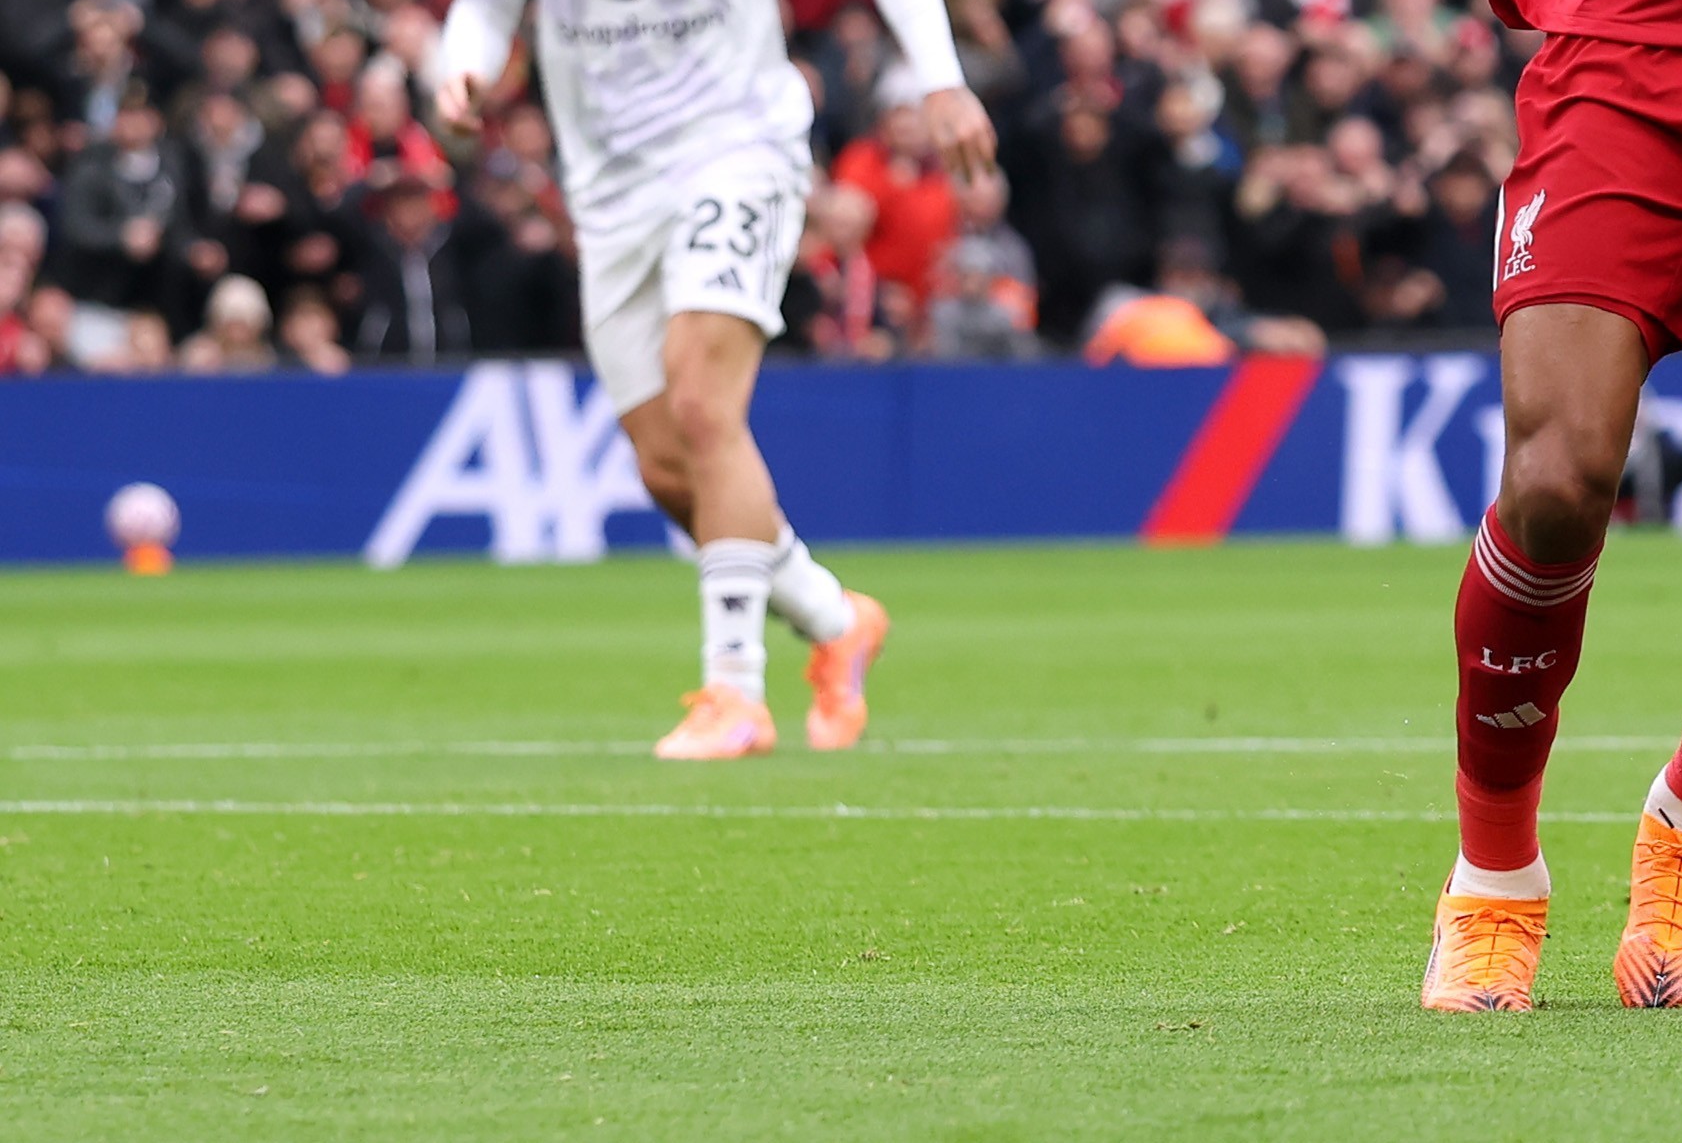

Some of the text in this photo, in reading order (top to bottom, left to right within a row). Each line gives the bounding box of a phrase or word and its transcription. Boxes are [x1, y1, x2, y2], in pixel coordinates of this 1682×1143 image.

[557, 11, 725, 48] Snapdragon
[686, 197, 759, 258] 23
[1481, 645, 1557, 674] LFC
